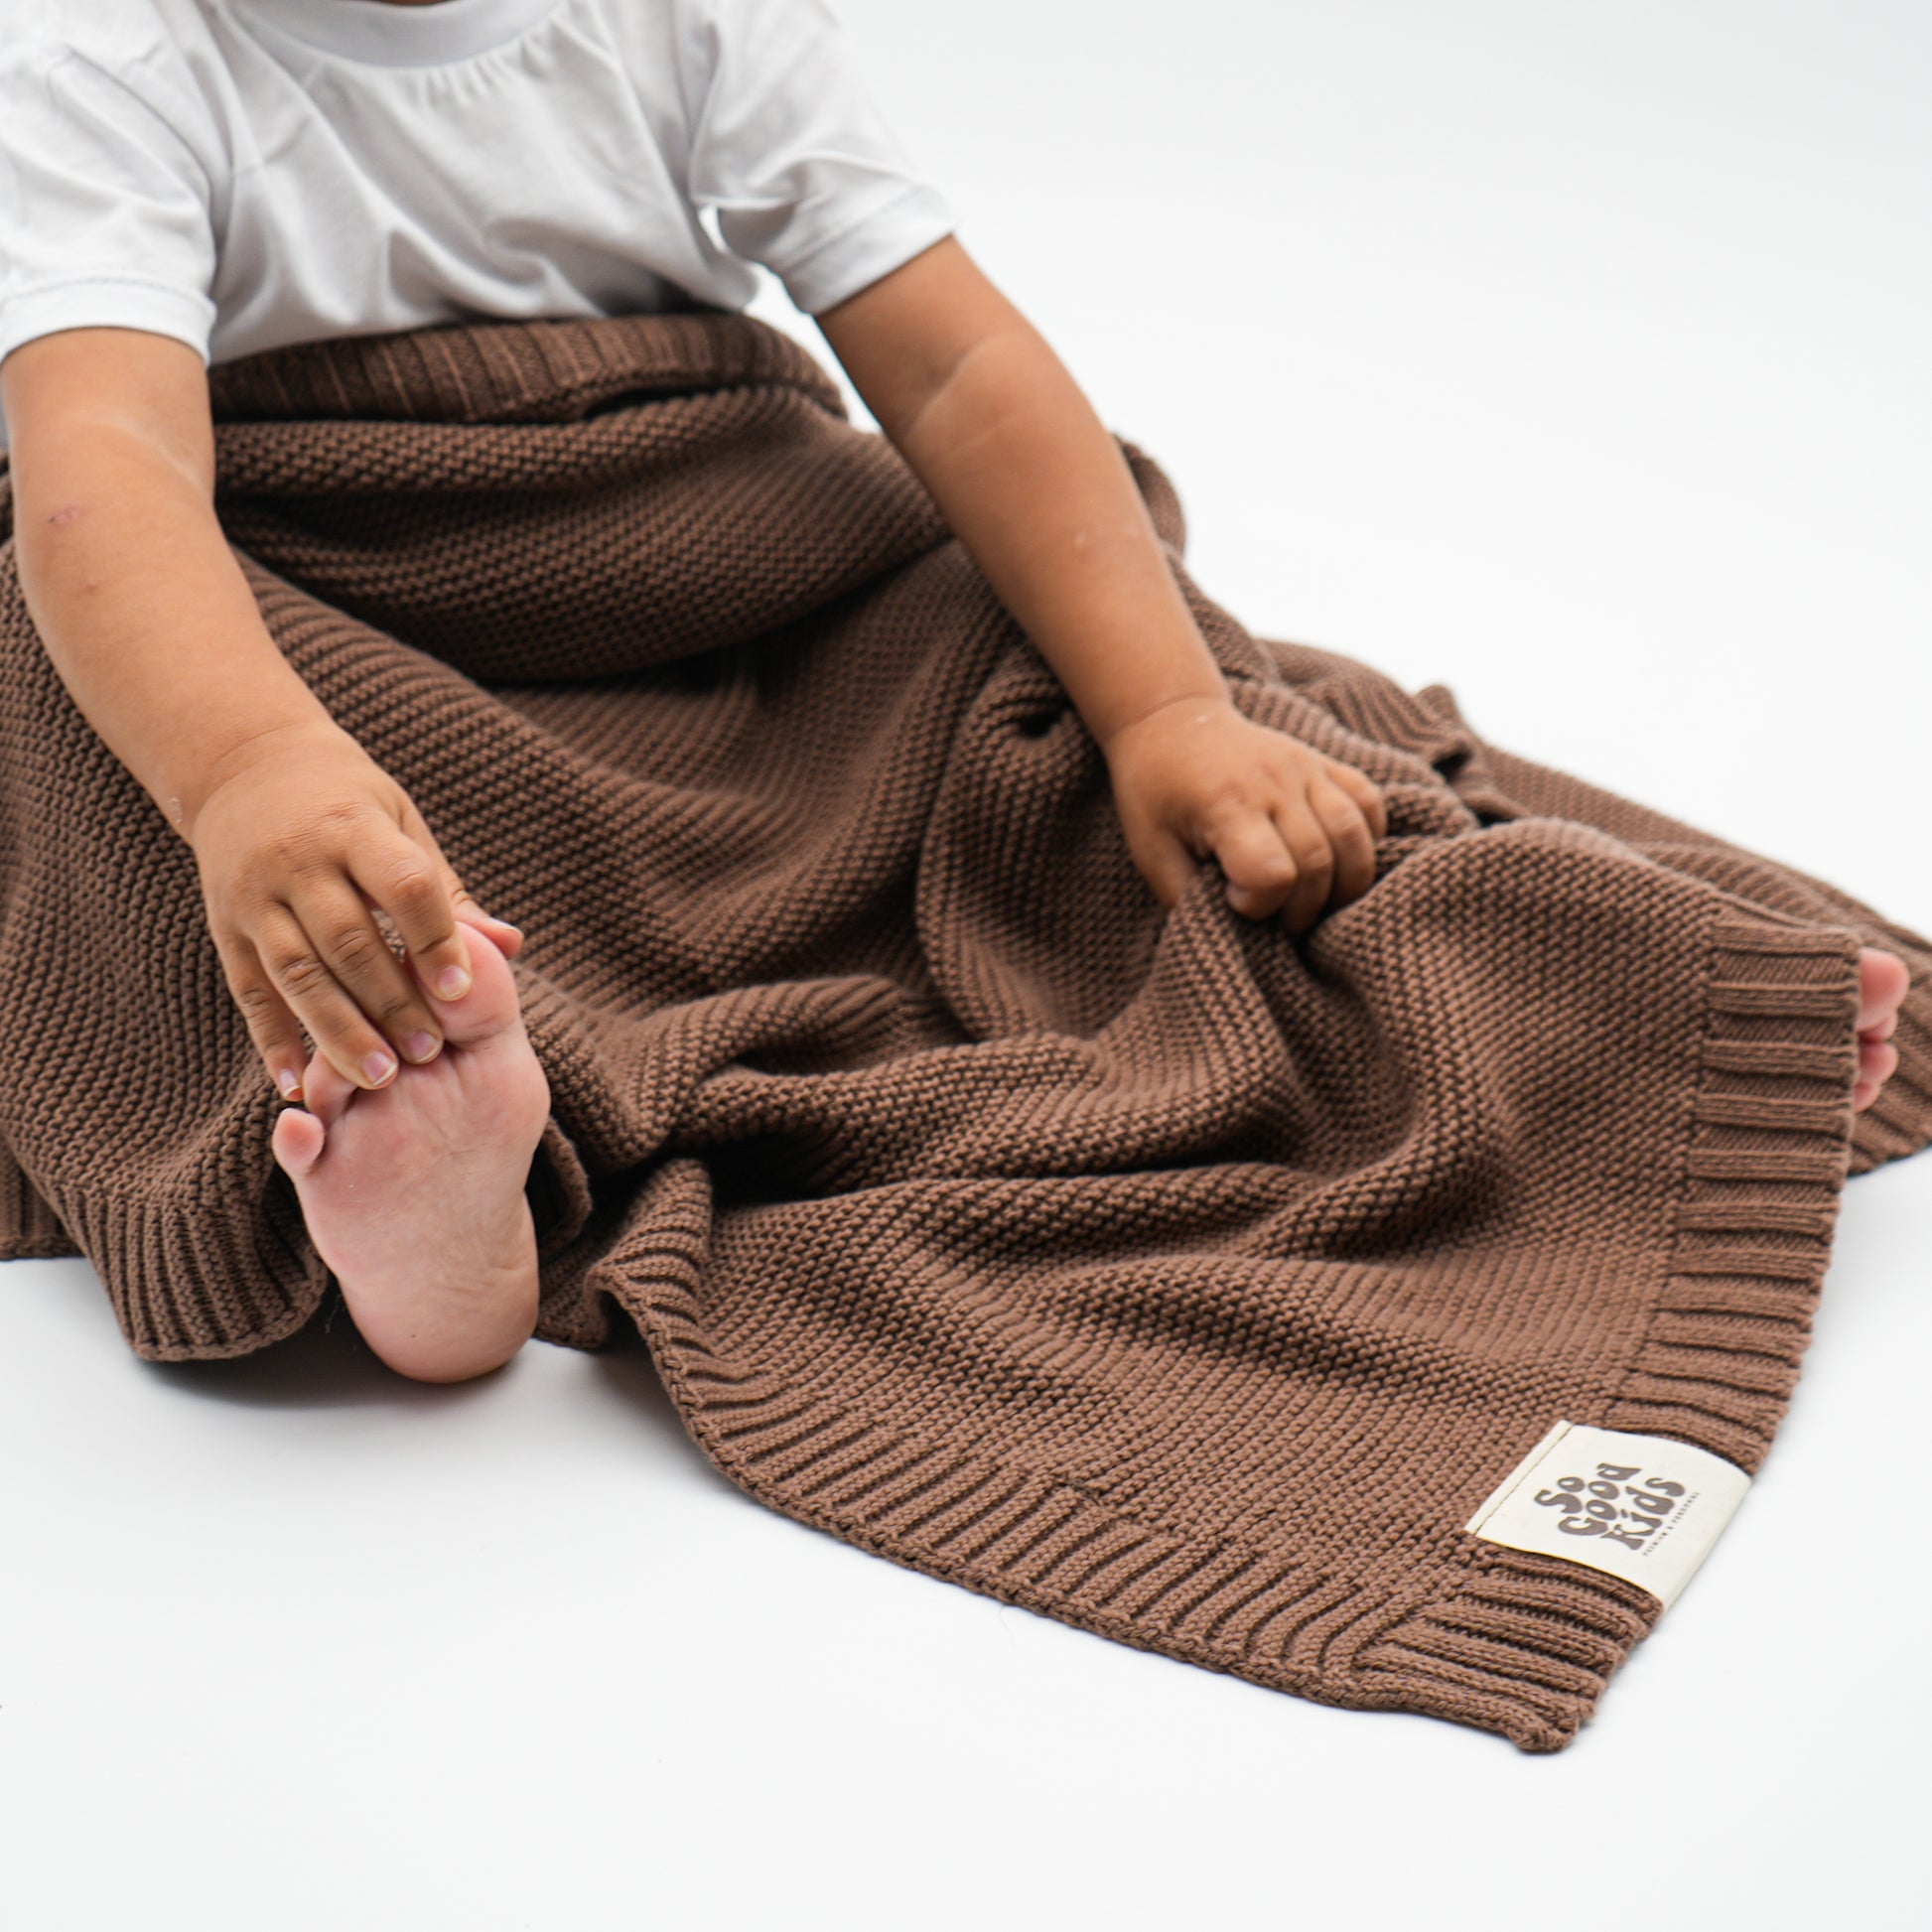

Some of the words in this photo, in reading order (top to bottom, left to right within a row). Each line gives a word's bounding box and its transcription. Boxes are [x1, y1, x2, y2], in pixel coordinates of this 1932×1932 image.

[1534, 1476, 1585, 1514] So
[1558, 1462, 1642, 1536] Good
[1600, 1477, 1686, 1551] Kids
